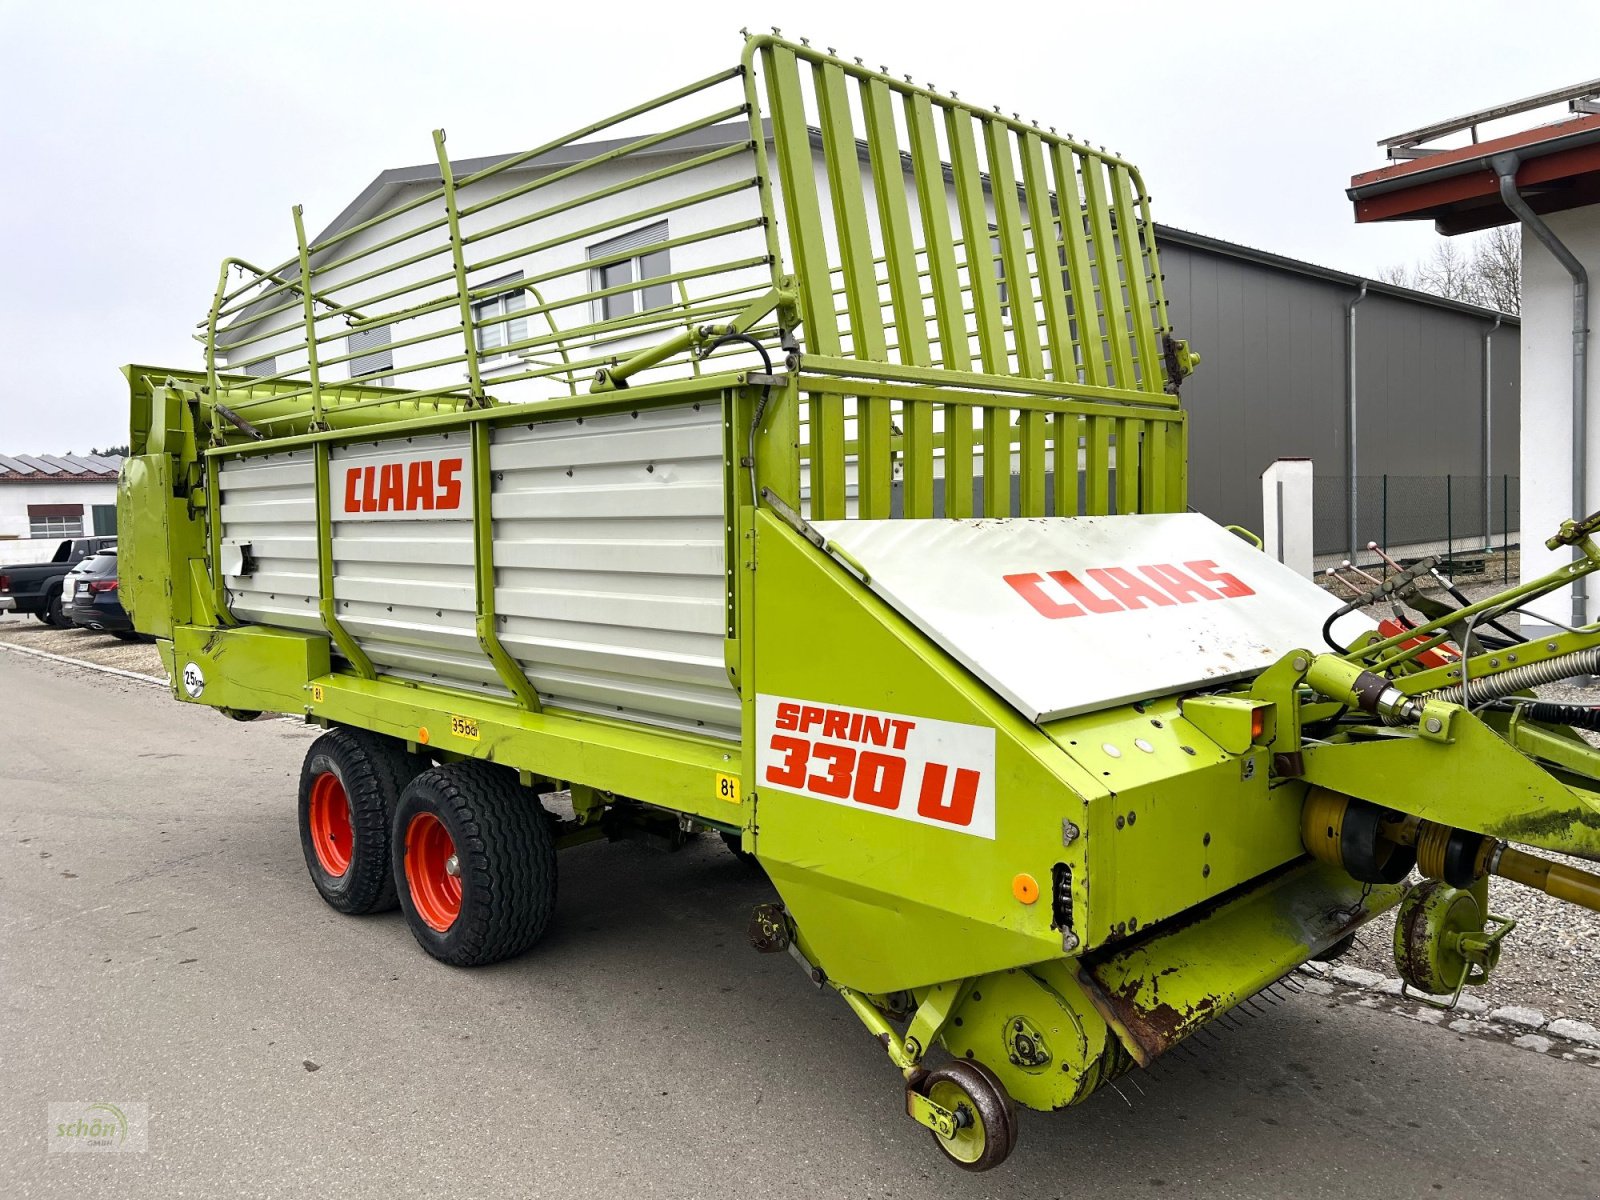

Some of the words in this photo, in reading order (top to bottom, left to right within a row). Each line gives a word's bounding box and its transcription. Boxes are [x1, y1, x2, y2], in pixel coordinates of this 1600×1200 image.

[344, 458, 463, 513] CLAAS
[1002, 559, 1256, 620] CLAAS
[775, 702, 916, 751] SPRINT
[721, 778, 734, 798] 8t
[765, 734, 907, 810] 330
[917, 761, 981, 827] U
